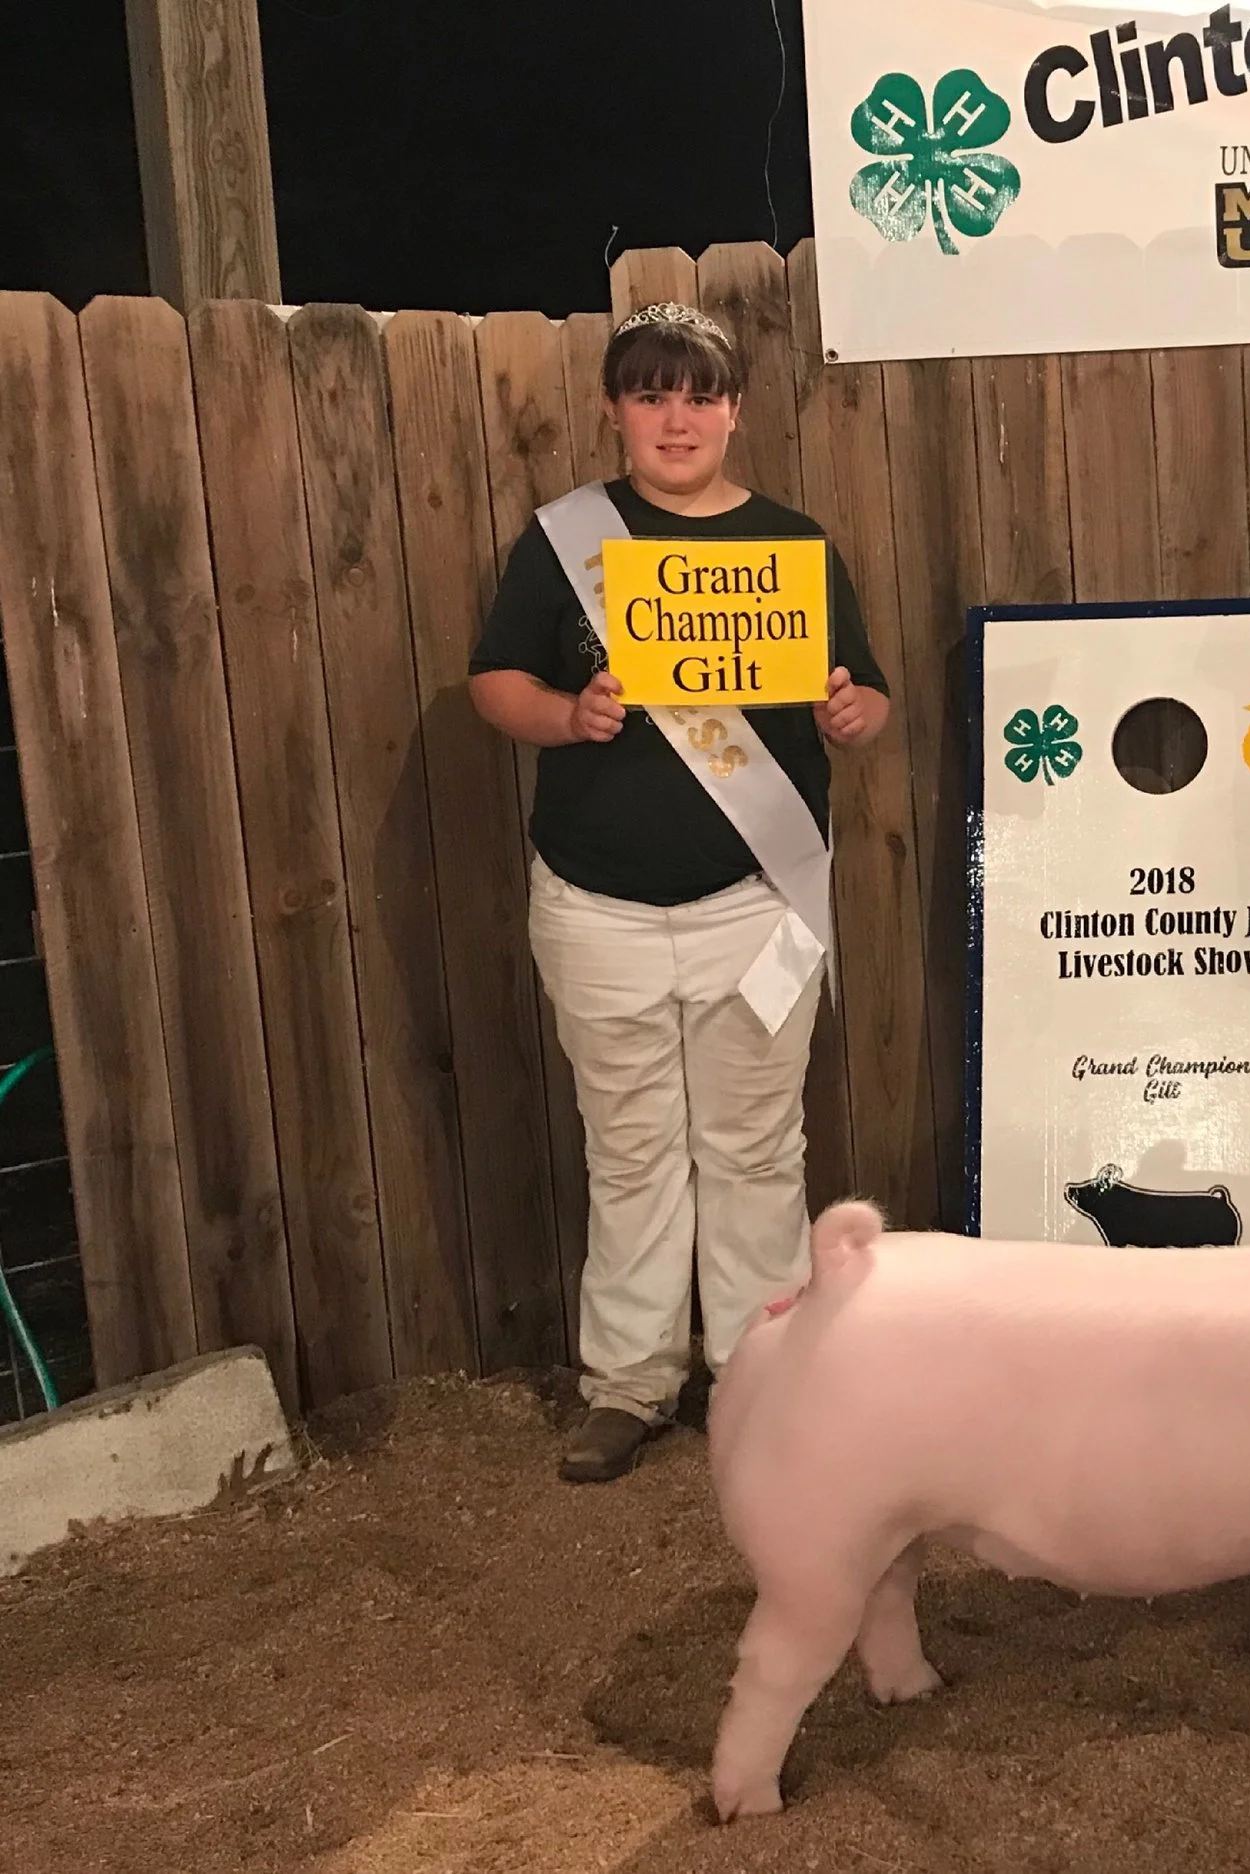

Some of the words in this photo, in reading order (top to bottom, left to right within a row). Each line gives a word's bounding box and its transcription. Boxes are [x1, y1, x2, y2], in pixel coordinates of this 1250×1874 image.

[871, 99, 916, 145] H
[942, 90, 986, 136] H
[951, 167, 996, 211] H
[657, 553, 780, 595] Grand
[625, 597, 809, 654] Champion
[672, 656, 762, 693] Gilt
[1129, 866, 1195, 895] 2018
[1040, 910, 1135, 939] Clinton
[1145, 906, 1237, 938] County
[1058, 948, 1185, 979] Livestock
[1071, 1054, 1138, 1081] Grand
[1143, 1078, 1182, 1105] Gilt
